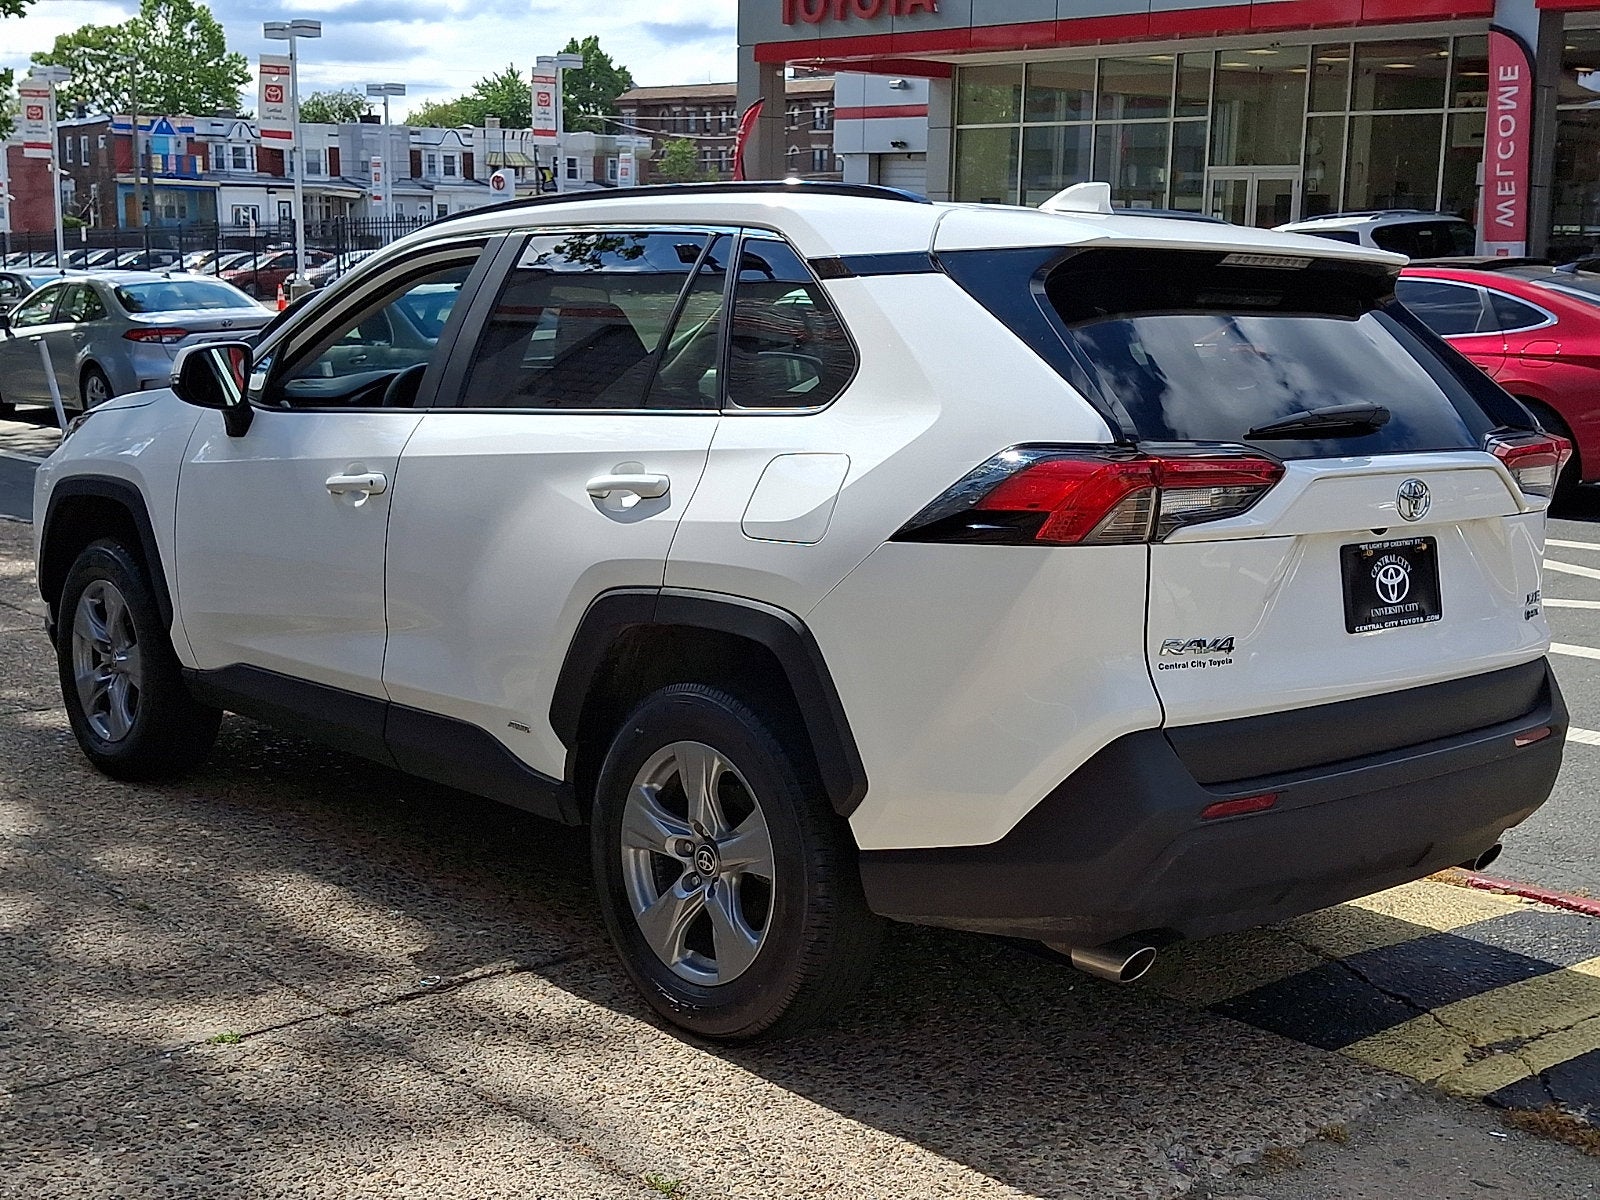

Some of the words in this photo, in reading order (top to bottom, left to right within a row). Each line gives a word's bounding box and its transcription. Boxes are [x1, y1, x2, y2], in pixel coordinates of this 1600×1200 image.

[1371, 554, 1396, 578] CENTRAL
[1397, 555, 1413, 573] CITY
[1371, 604, 1404, 616] UNIVERSITY
[1405, 603, 1418, 612] CITY
[1355, 623, 1383, 632] CENTRAL
[1384, 620, 1398, 628] CITY
[1400, 617, 1424, 625] TOYOTA
[1159, 635, 1235, 656] RAV4
[1158, 662, 1189, 670] Central
[1191, 660, 1207, 668] City
[1208, 658, 1233, 667] Toyota
